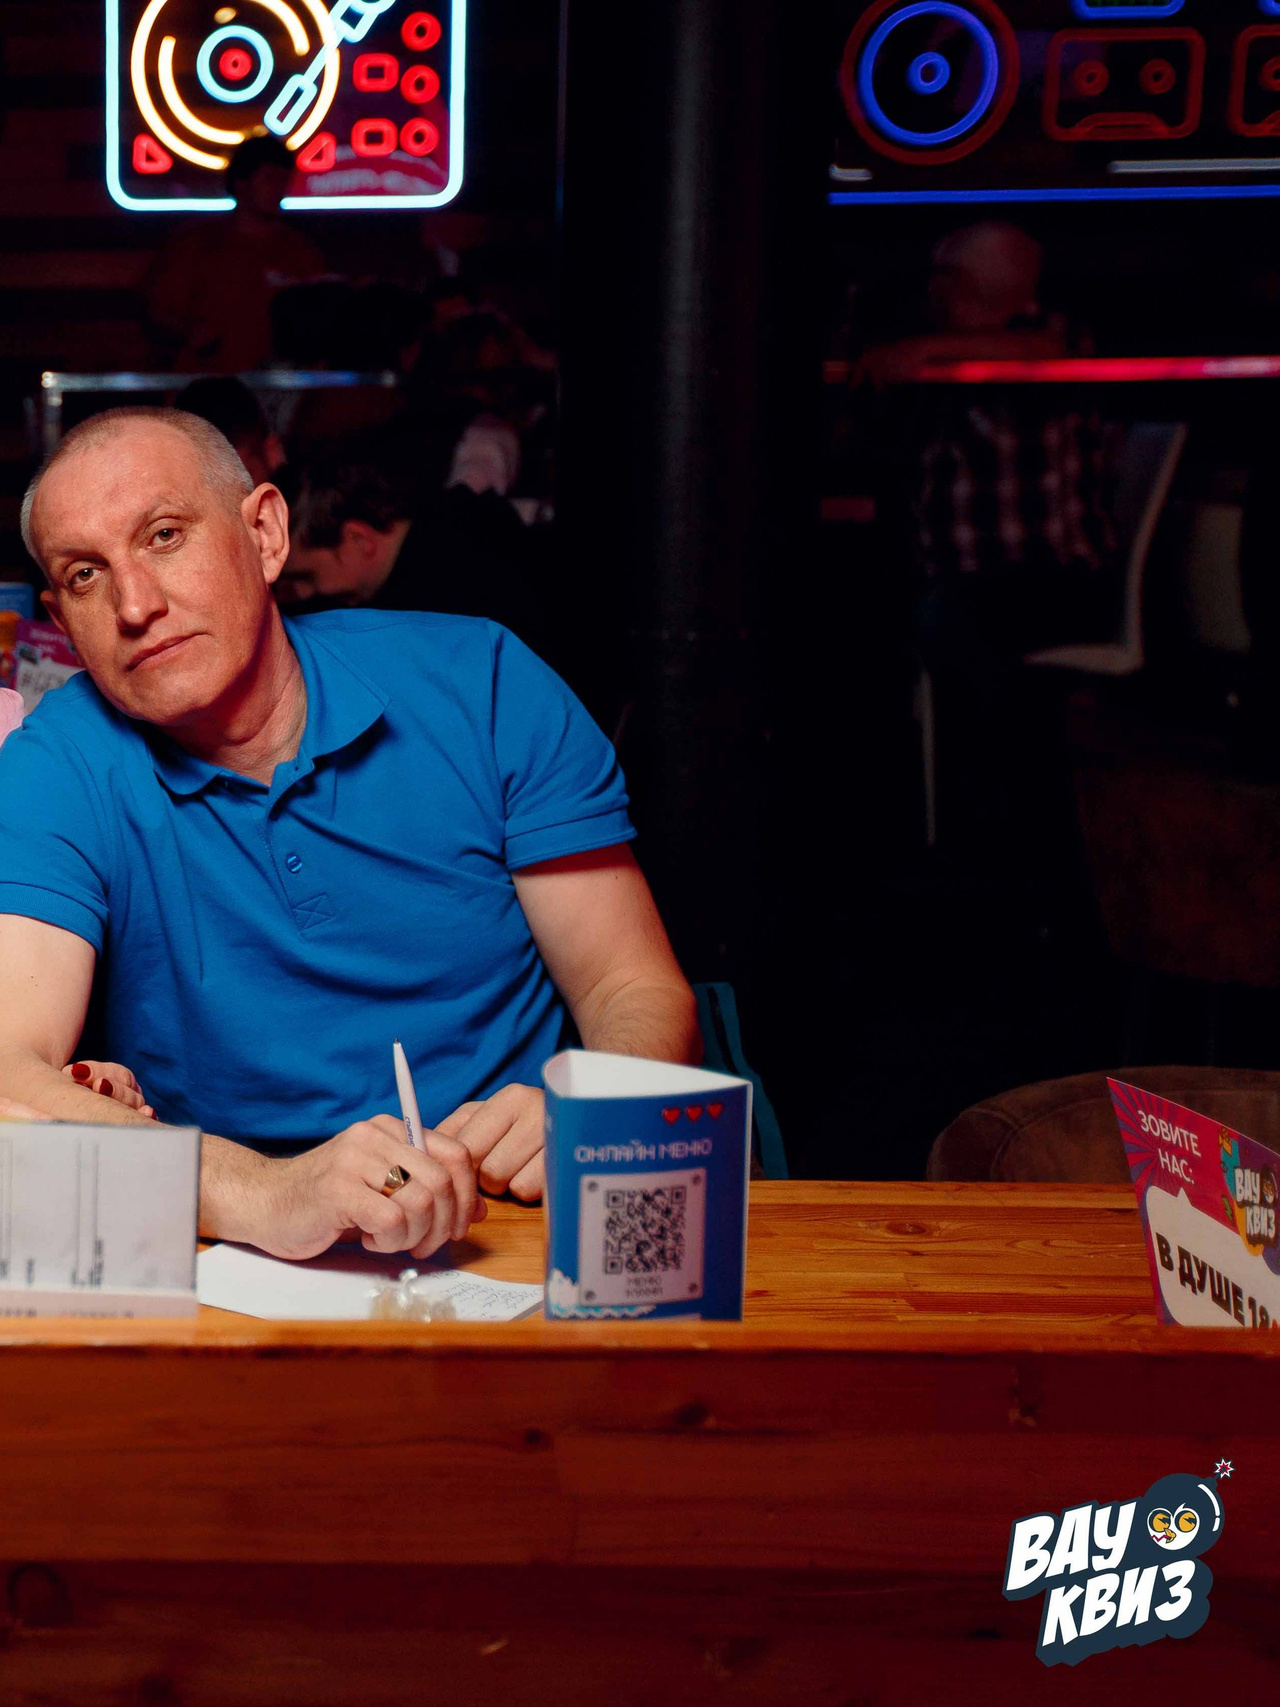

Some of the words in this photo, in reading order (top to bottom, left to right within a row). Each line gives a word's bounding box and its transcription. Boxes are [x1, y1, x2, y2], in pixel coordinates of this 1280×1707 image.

[573, 1138, 656, 1163] ОНЛАЙН
[658, 1137, 713, 1160] МЕНЮ
[1137, 1109, 1202, 1158] ЗОВИТЕ
[1158, 1148, 1195, 1185] НАС:
[1234, 1167, 1260, 1204] ВАУ
[1246, 1205, 1276, 1239] КВИЗ
[1155, 1232, 1174, 1272] В
[1177, 1244, 1246, 1327] ДУШЕ
